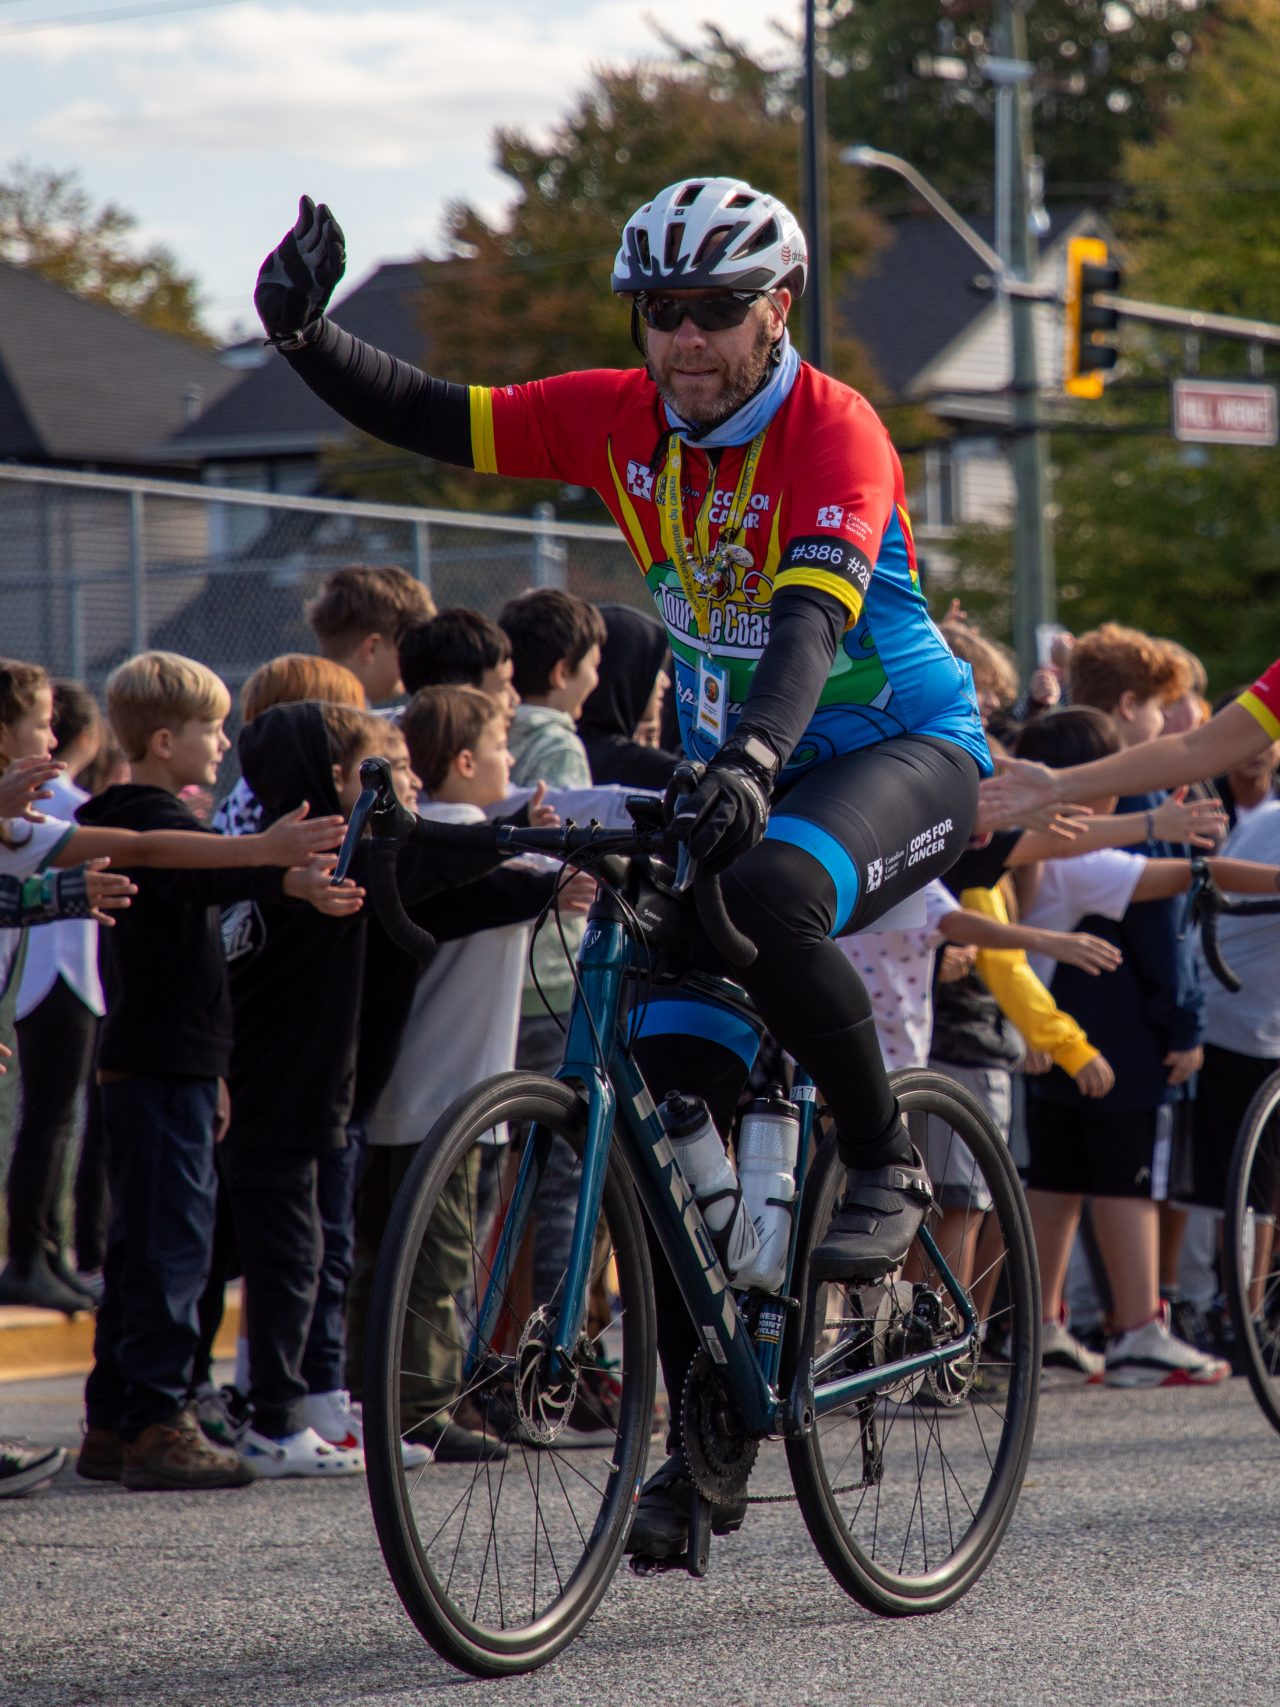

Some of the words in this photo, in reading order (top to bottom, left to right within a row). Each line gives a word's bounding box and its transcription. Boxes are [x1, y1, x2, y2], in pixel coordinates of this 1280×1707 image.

[668, 509, 680, 521] du
[791, 544, 843, 564] #386
[658, 581, 696, 632] Tour
[910, 829, 932, 853] COPS
[932, 818, 954, 840] FOR
[907, 838, 945, 867] CANCER
